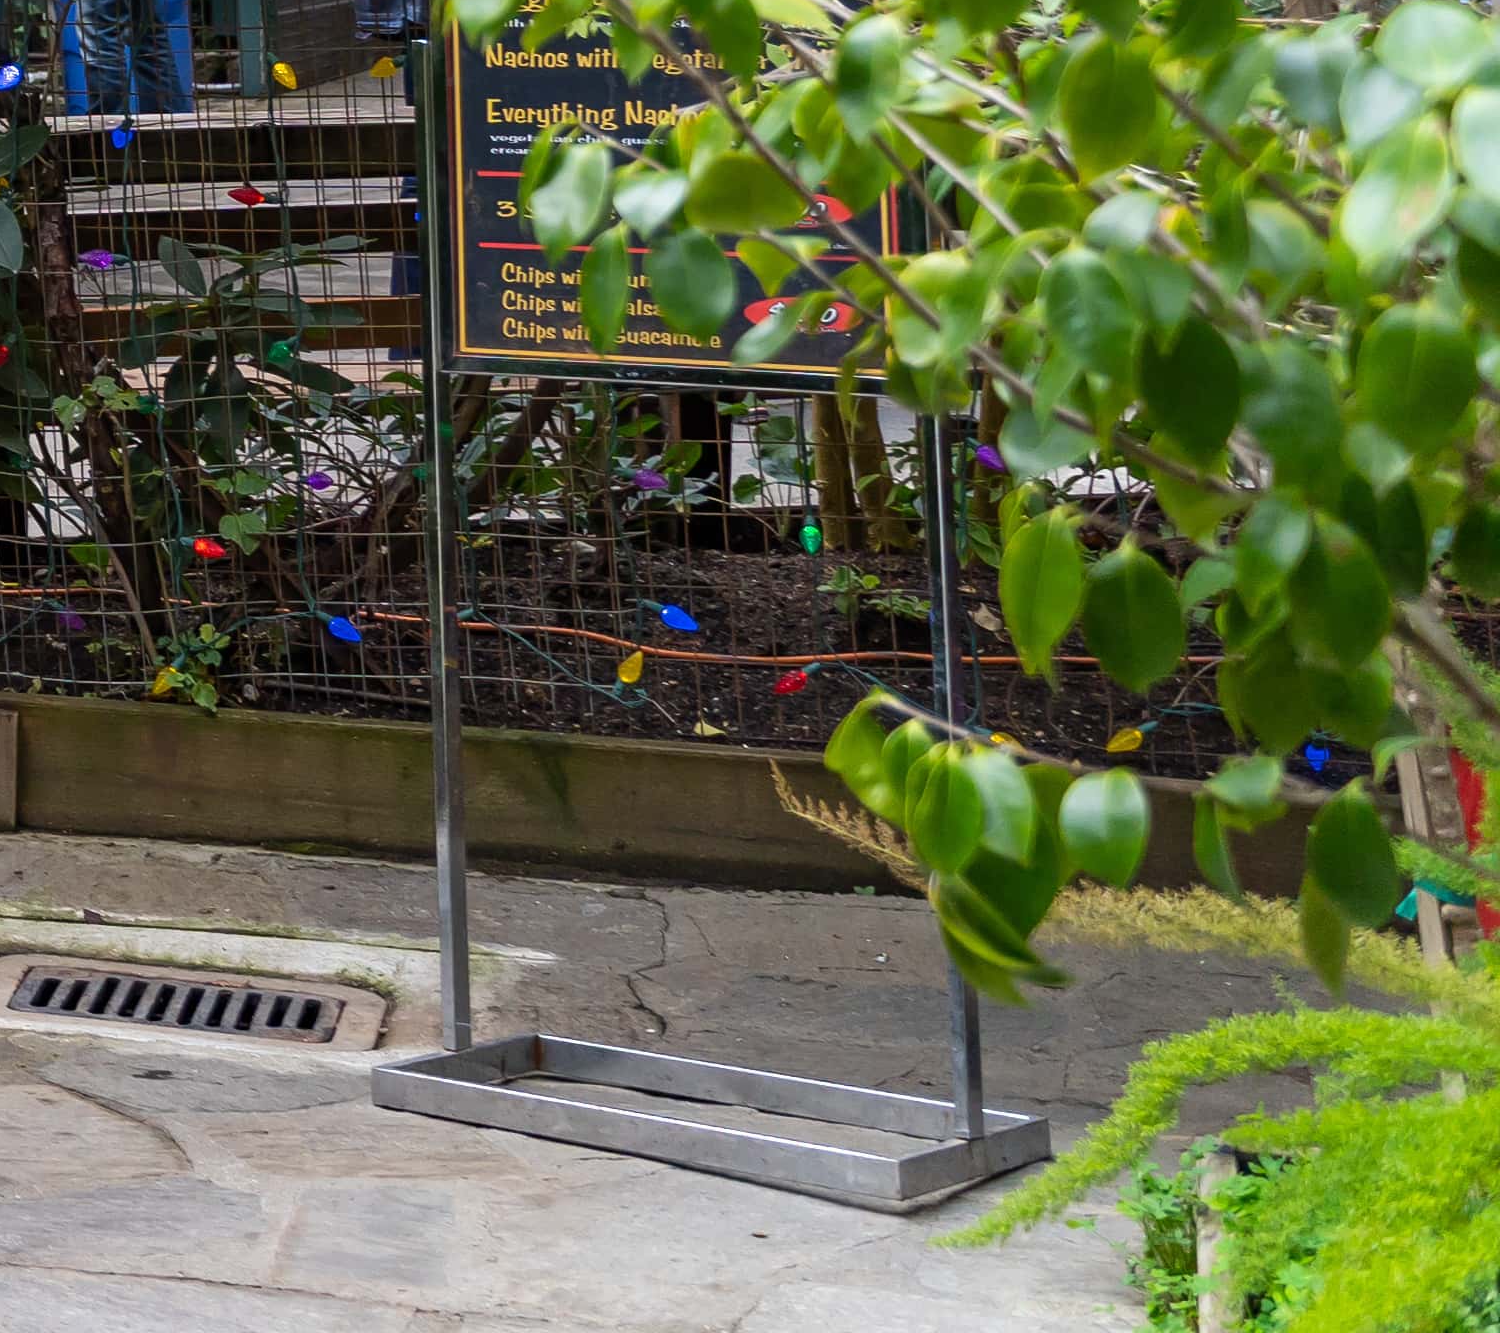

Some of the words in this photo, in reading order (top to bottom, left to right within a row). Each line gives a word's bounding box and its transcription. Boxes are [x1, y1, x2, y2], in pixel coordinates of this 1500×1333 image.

[485, 44, 567, 68] Nachos
[485, 99, 616, 130] Everything
[501, 263, 555, 288] Chips
[501, 290, 555, 316] Chips
[502, 318, 555, 344] Chips
